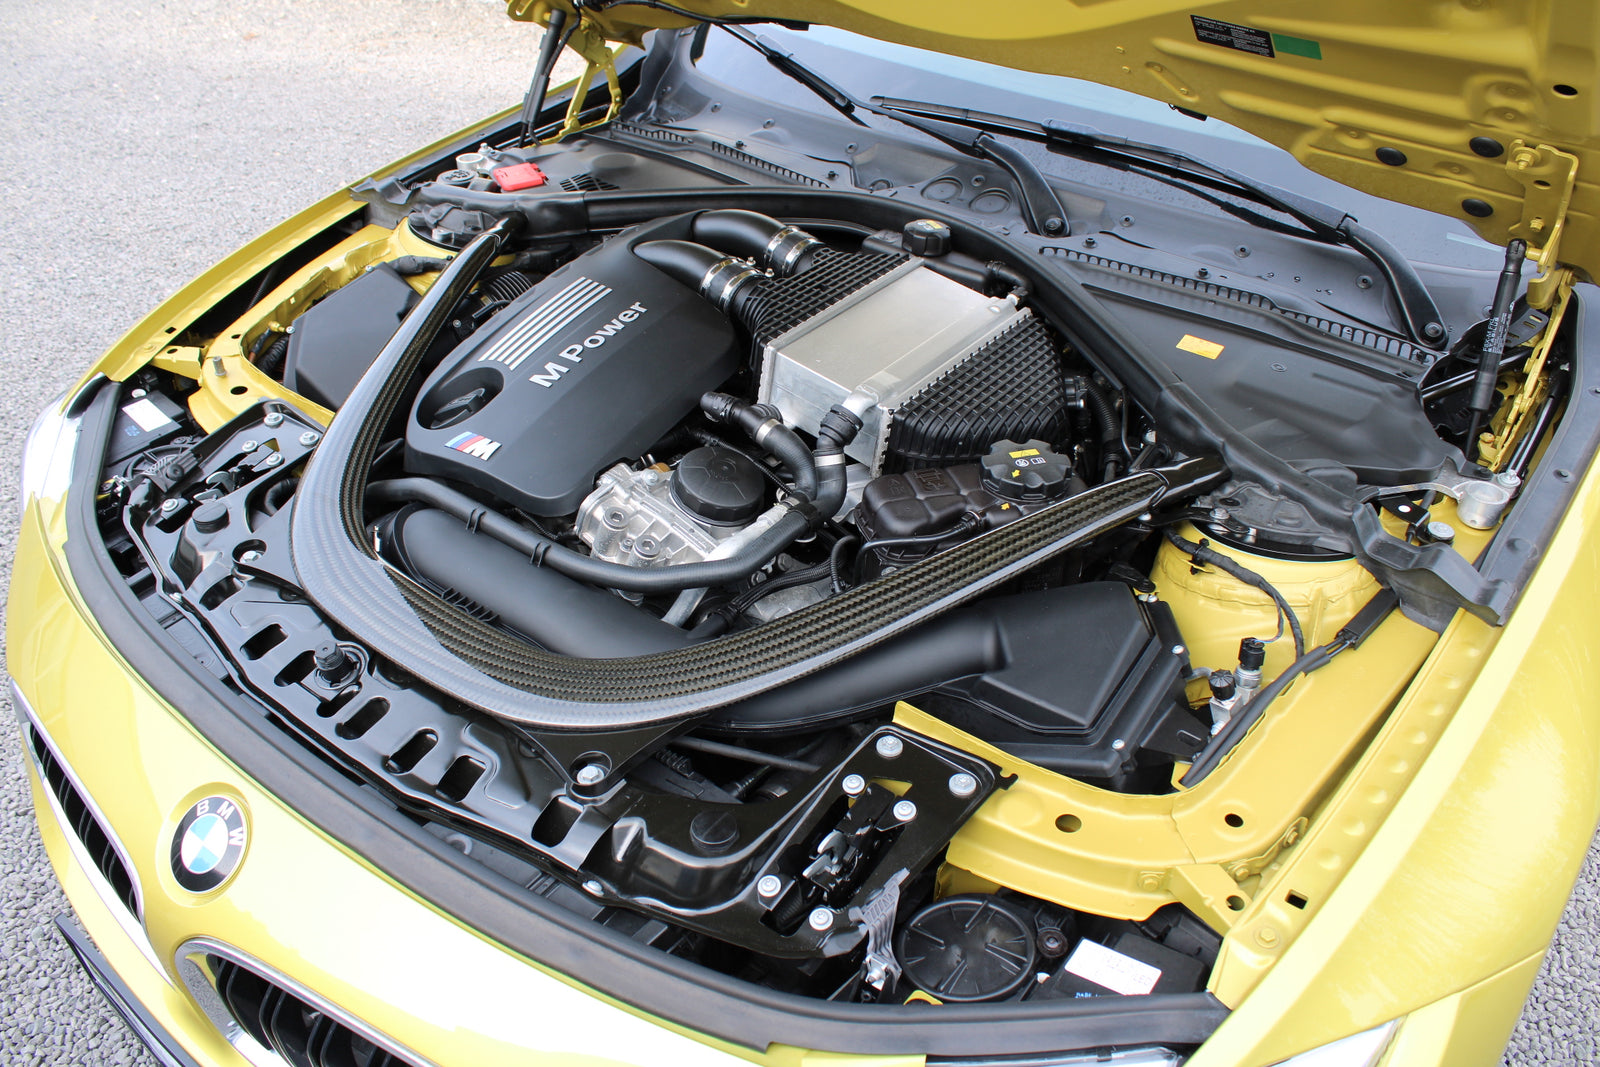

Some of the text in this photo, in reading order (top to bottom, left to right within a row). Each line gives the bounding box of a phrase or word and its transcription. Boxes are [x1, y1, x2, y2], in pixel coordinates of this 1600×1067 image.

[529, 301, 648, 388] M Power
[465, 439, 502, 461] M
[196, 799, 244, 847] BMW
